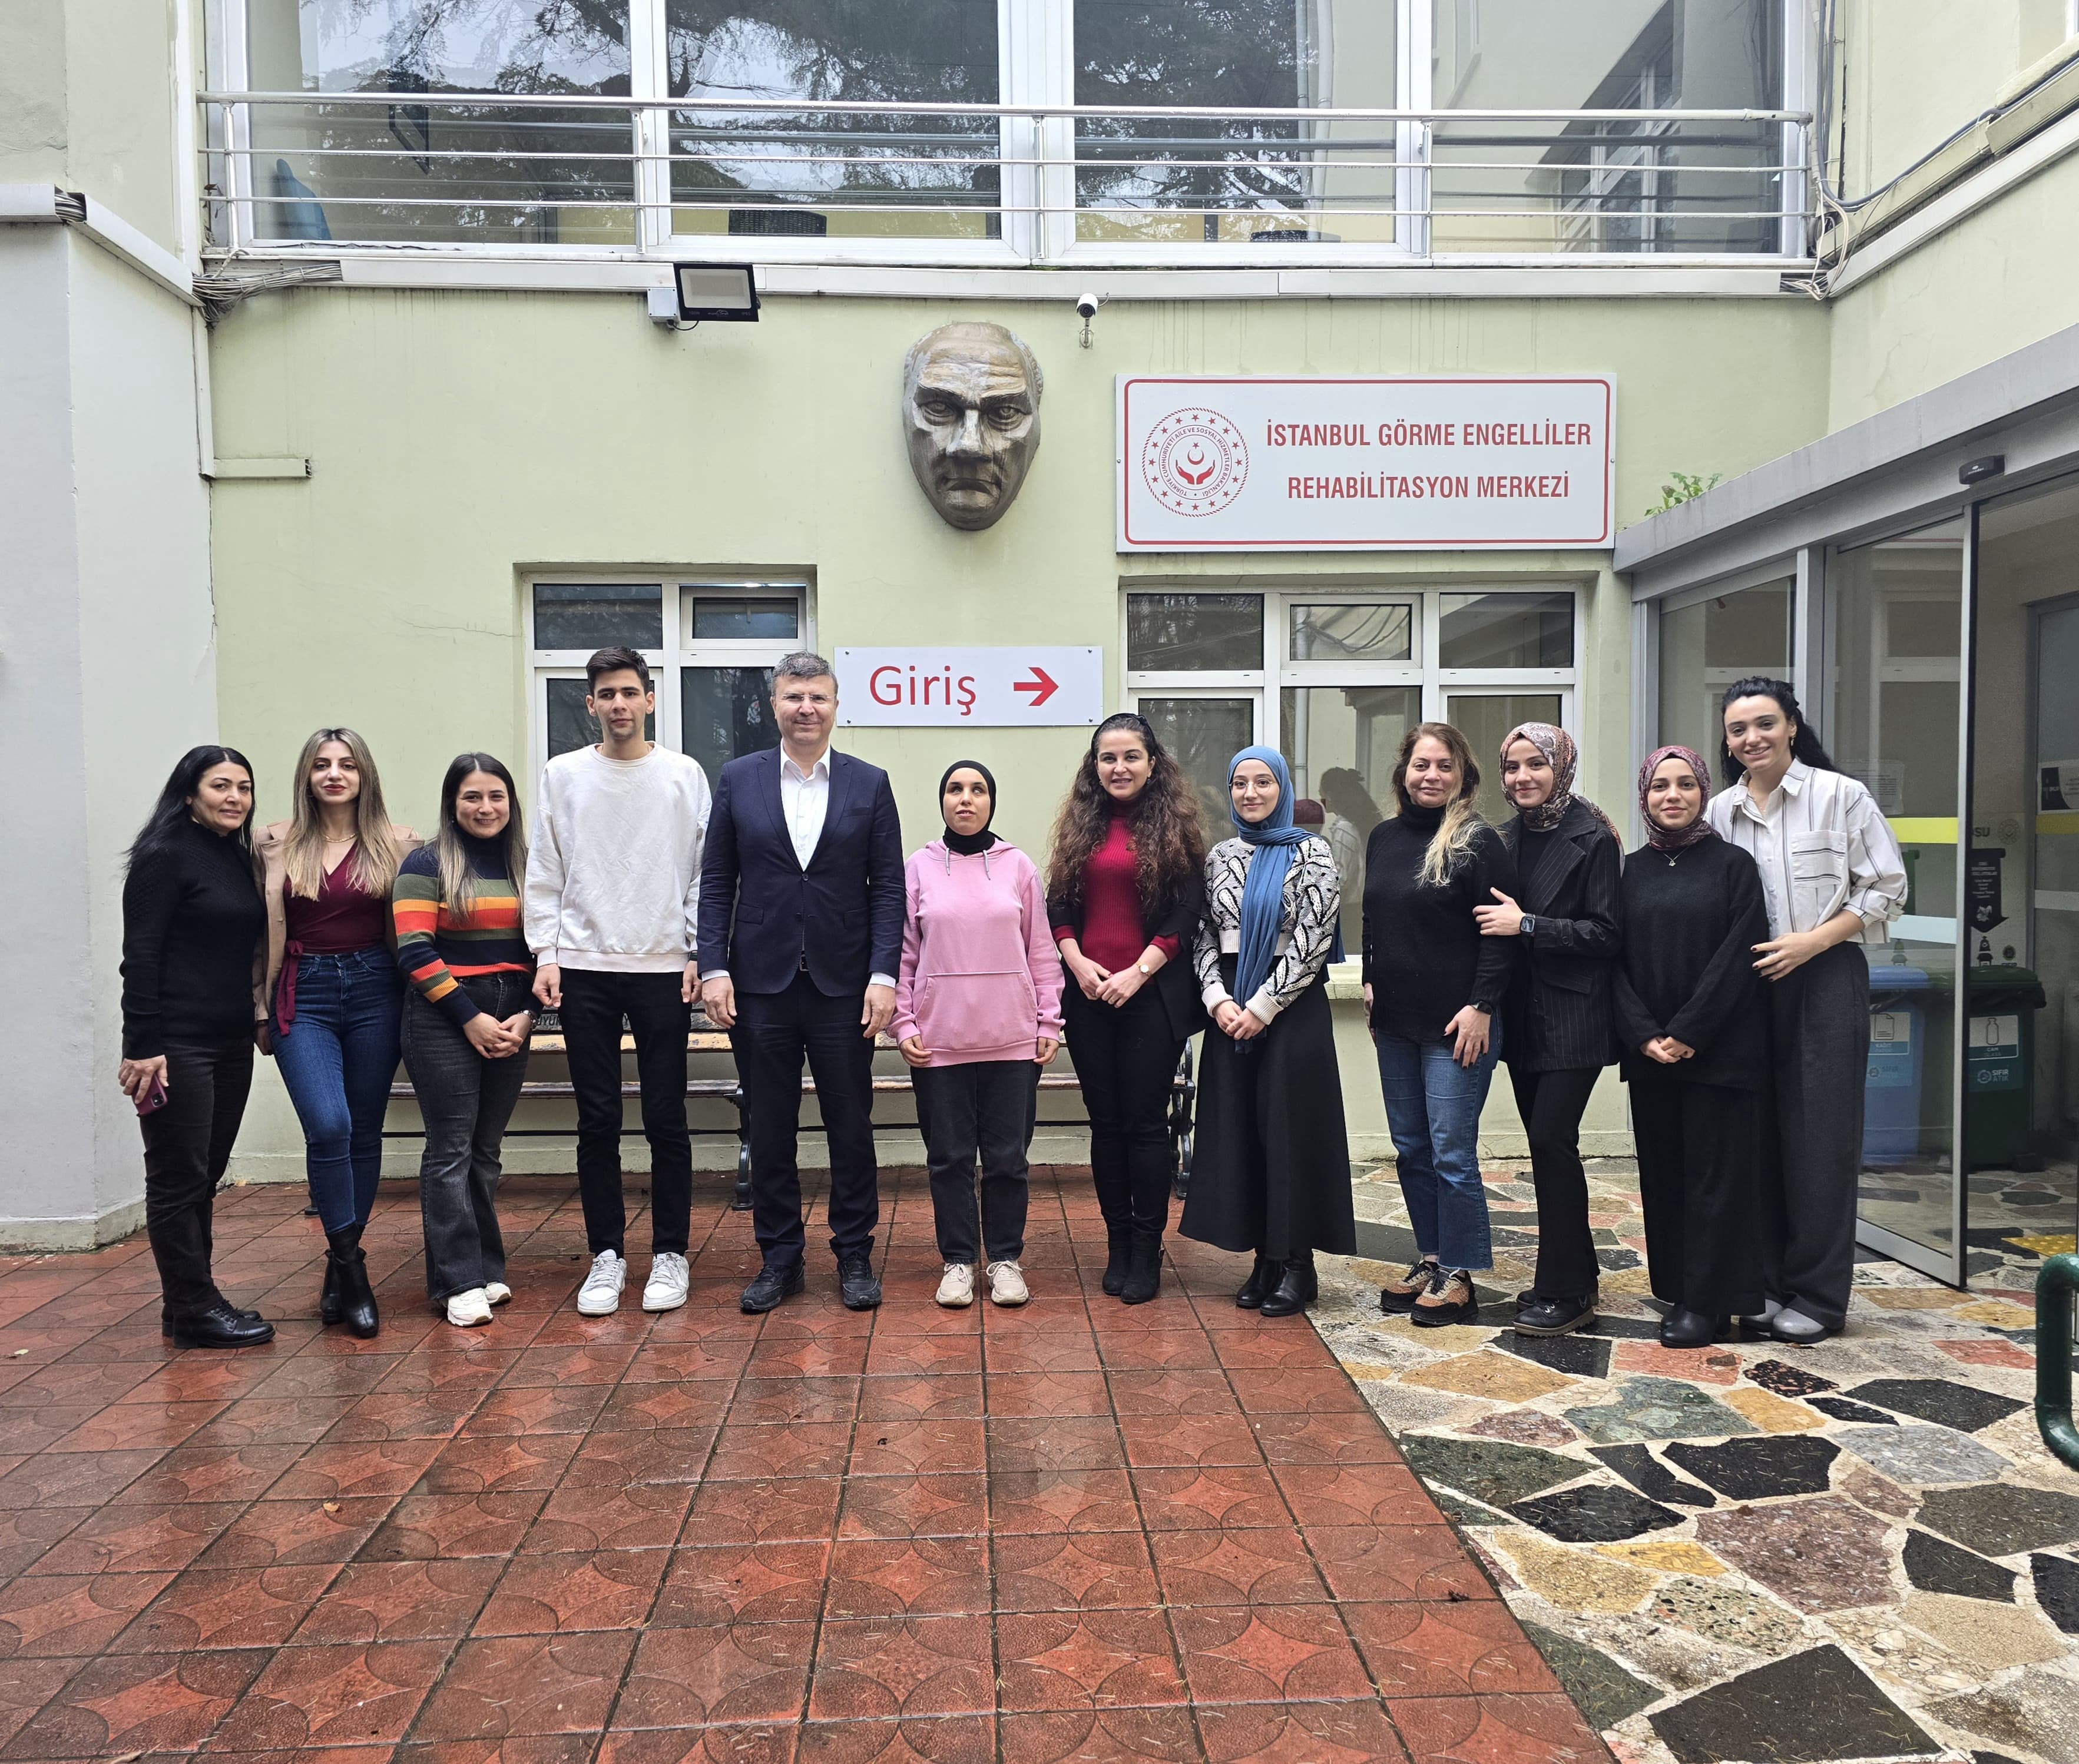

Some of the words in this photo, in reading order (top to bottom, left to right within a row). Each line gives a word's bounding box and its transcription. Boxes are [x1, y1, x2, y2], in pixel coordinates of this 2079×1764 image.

[1175, 430, 1187, 439] AİLE
[1196, 427, 1217, 440] SOSYAL
[1217, 438, 1230, 472] HİZMETLER
[1267, 419, 1370, 446] İSTANBUL
[1379, 419, 1455, 446] GÖRME
[1464, 418, 1591, 445] ENGELLİLER
[1289, 471, 1468, 498] REHABİLİTASYON
[1477, 470, 1569, 498] MERKEZİ
[870, 665, 976, 716] Giriş
